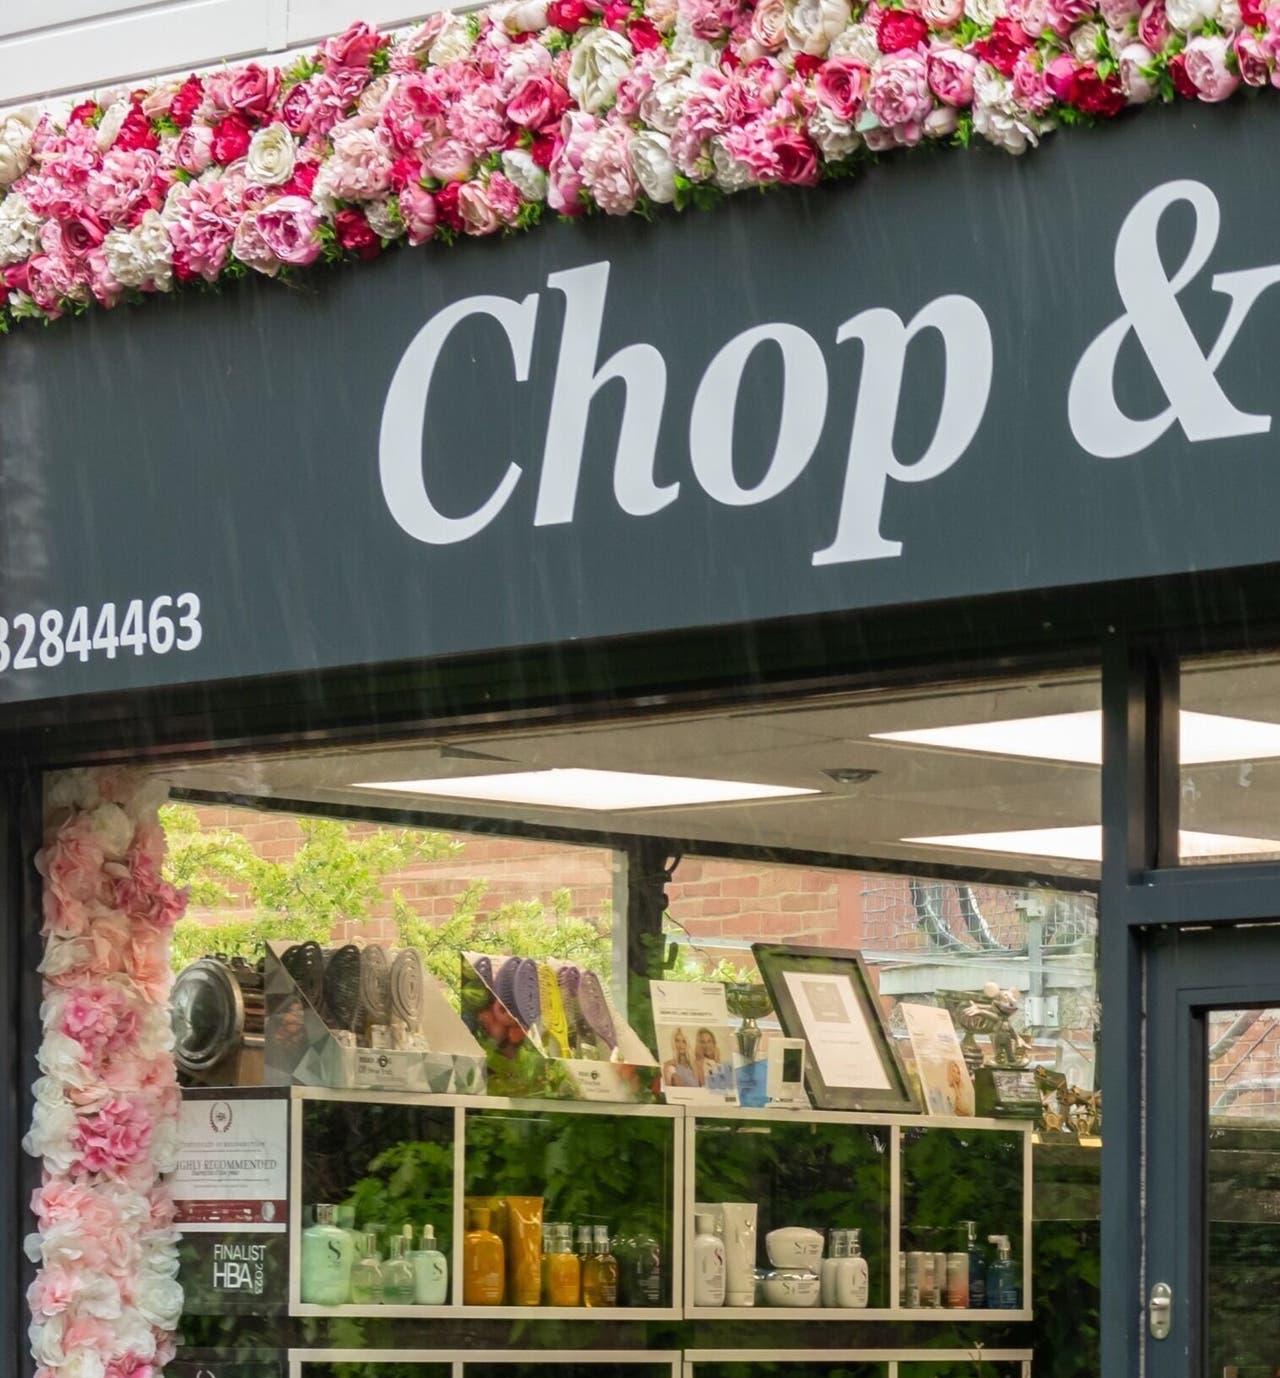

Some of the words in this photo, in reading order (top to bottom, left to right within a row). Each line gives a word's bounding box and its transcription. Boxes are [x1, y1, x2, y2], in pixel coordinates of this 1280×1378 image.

[378, 261, 993, 566] Chop
[204, 1159, 278, 1171] RECOMMENDED
[213, 1243, 267, 1261] FINALIST
[213, 1262, 253, 1289] HBA
